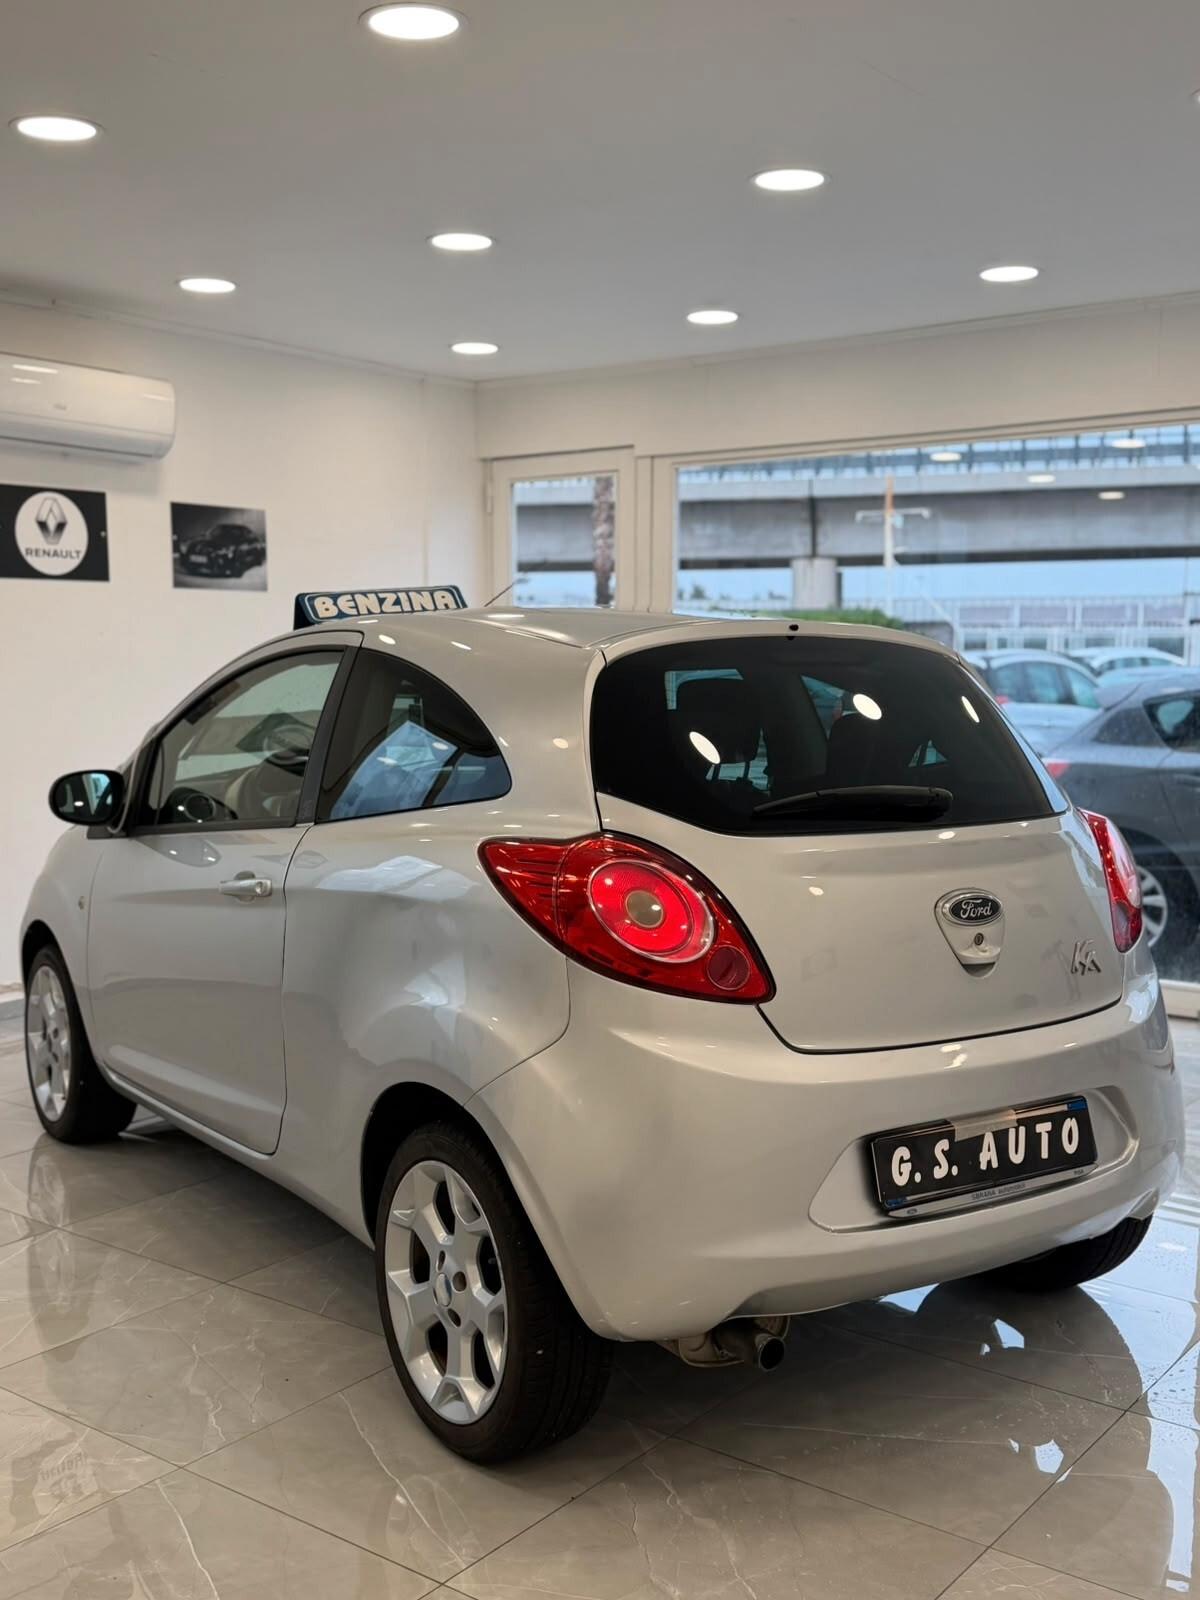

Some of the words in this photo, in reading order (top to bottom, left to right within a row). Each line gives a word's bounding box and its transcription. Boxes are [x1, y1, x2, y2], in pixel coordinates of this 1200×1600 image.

[25, 547, 83, 560] RENAULT
[314, 591, 457, 618] BENZINA
[960, 899, 992, 919] Ford
[979, 1117, 1079, 1170] AUTO
